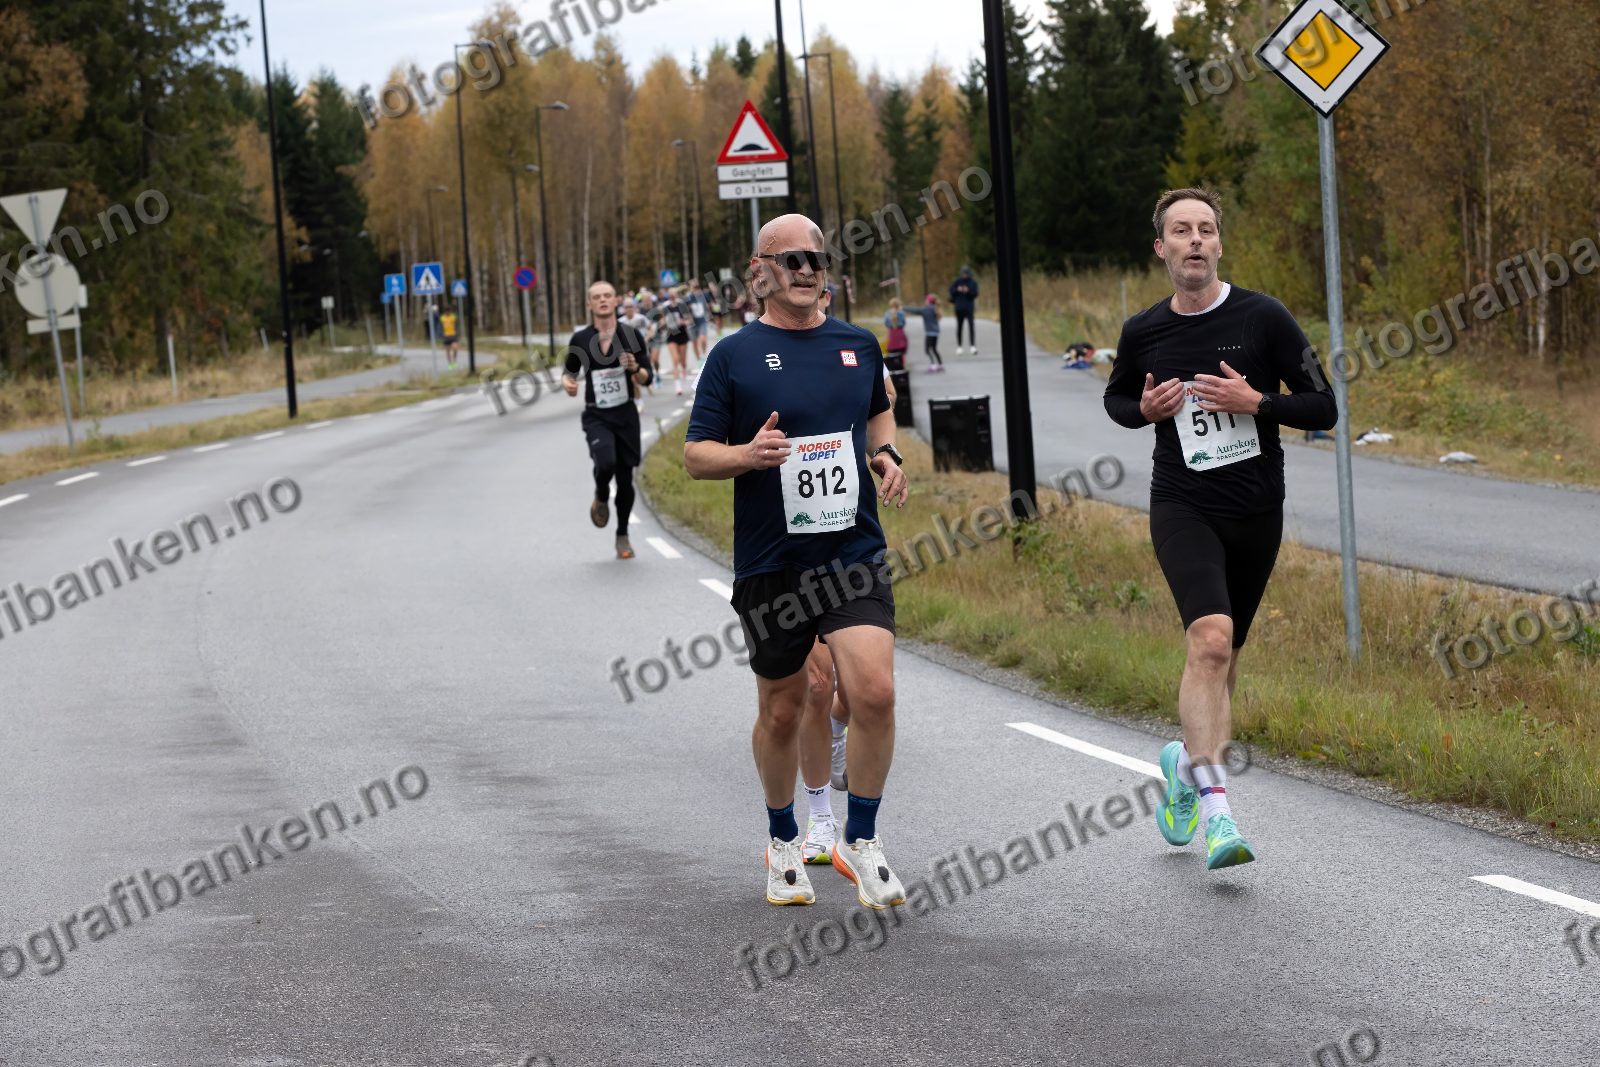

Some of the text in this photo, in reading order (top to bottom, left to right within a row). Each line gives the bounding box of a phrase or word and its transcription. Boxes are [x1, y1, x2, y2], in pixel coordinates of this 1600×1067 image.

[731, 167, 773, 178] Gangfelt
[600, 381, 621, 394] 353
[798, 440, 842, 454] NORGES
[1216, 438, 1257, 454] Aurskog
[802, 450, 837, 461] LØPET
[798, 466, 847, 498] 812
[820, 507, 856, 520] Aurskog
